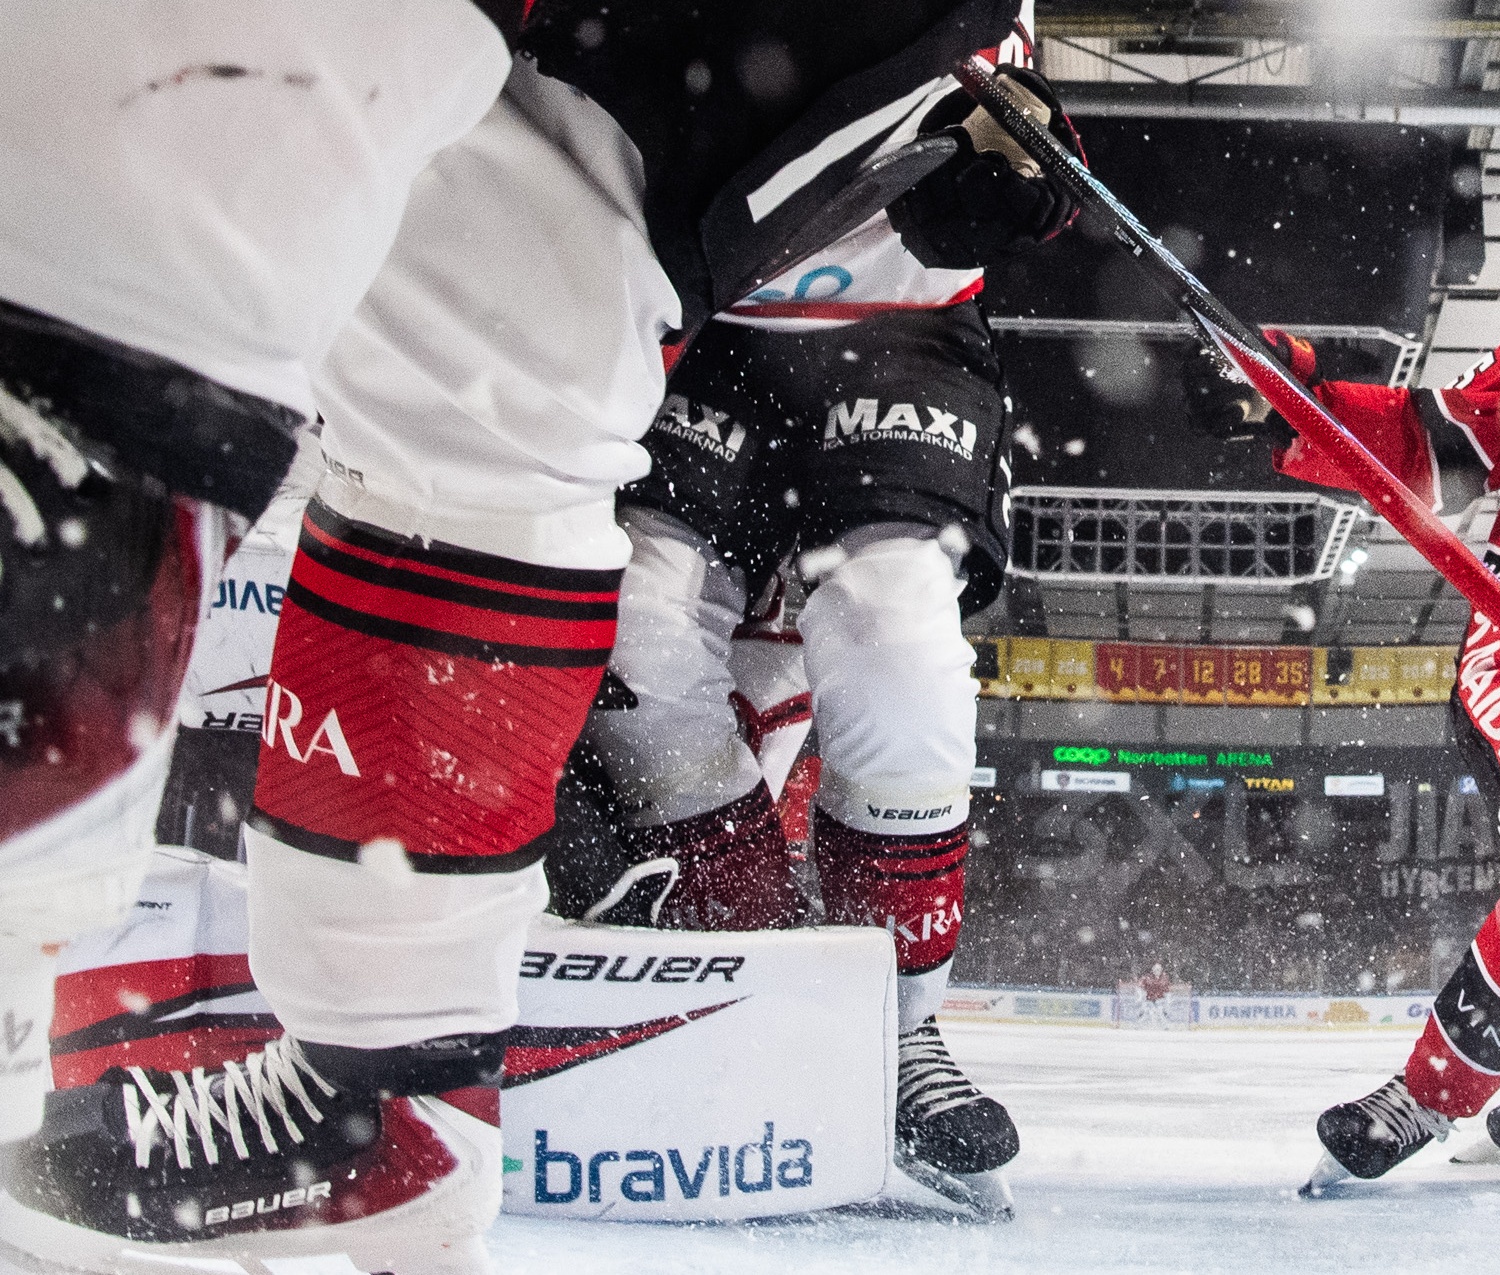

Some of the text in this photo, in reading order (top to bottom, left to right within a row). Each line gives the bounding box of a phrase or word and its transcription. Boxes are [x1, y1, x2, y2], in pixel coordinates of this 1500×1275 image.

[825, 397, 977, 452] MAXI
[850, 428, 974, 461] STORMARKNAD
[1109, 658, 1125, 682] 4
[1191, 659, 1216, 685] 12
[1232, 660, 1263, 685] 28
[1275, 661, 1304, 685] 35
[1244, 777, 1295, 791] TITAN
[534, 1121, 814, 1204] bravida
[204, 1180, 332, 1227] BAUER
